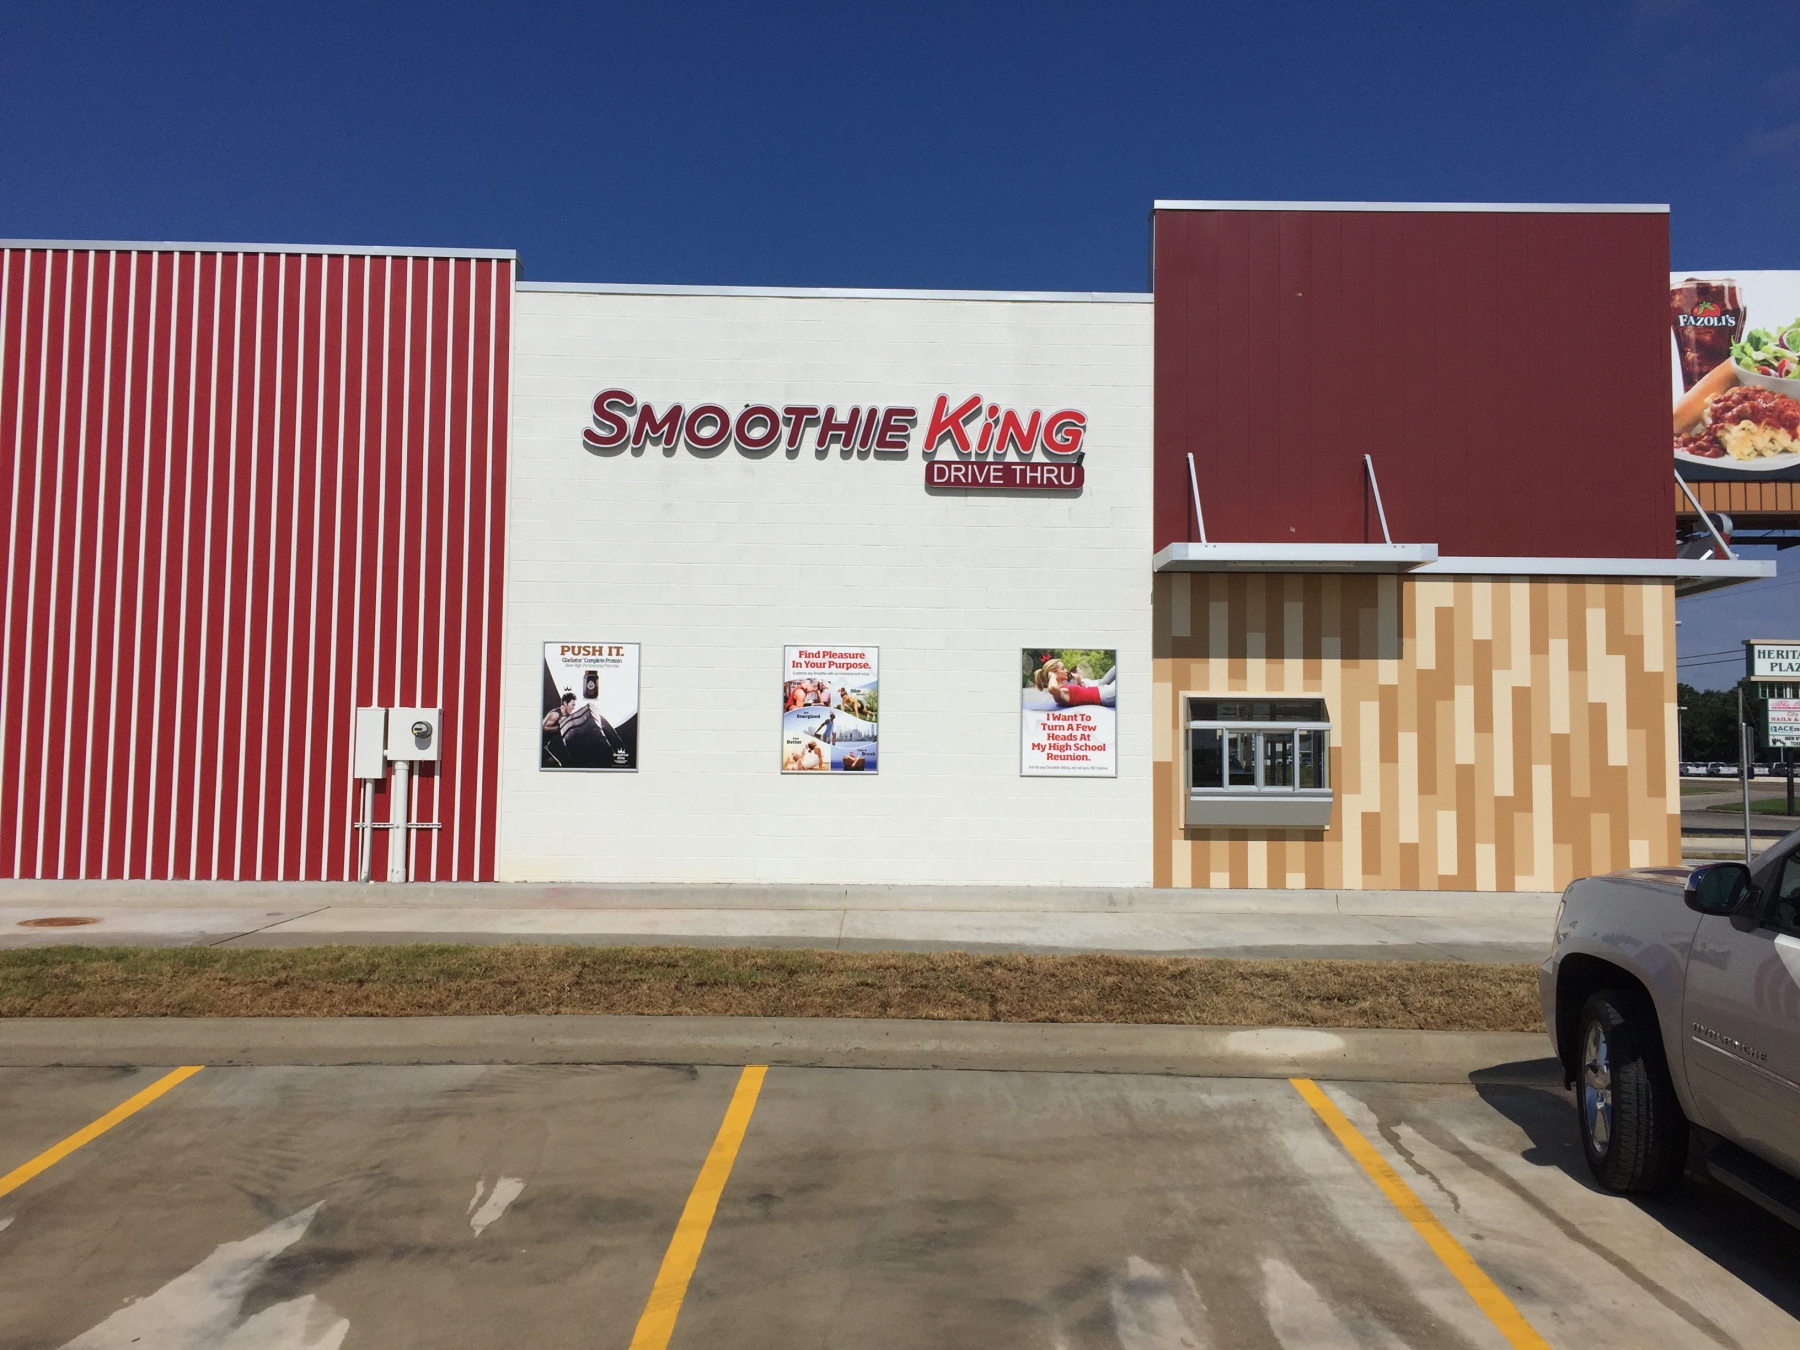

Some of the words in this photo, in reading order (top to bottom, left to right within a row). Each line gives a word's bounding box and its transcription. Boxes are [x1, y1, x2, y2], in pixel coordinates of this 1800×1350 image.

[1678, 314, 1736, 327] FAZOLI'S
[582, 388, 918, 452] SMOOTHIE
[933, 464, 1004, 485] DRIVE
[1011, 465, 1076, 486] THRU
[560, 645, 603, 656] PUSH
[608, 646, 624, 656] IT.
[798, 650, 820, 659] Find
[822, 650, 865, 659] Pleasure
[792, 660, 803, 669] In
[804, 660, 827, 669] Your
[828, 660, 872, 671] Purpose.
[1046, 713, 1051, 721] I
[1052, 713, 1078, 722] Want
[1079, 713, 1092, 722] To
[1041, 723, 1065, 731] Turn
[1066, 723, 1075, 731] A
[1076, 723, 1097, 732] Few
[1046, 733, 1077, 741] Heads
[1079, 733, 1091, 741] At
[1031, 742, 1047, 753] My
[1048, 742, 1072, 753] High
[1073, 743, 1106, 752] School
[1046, 753, 1091, 761] Reunion.
